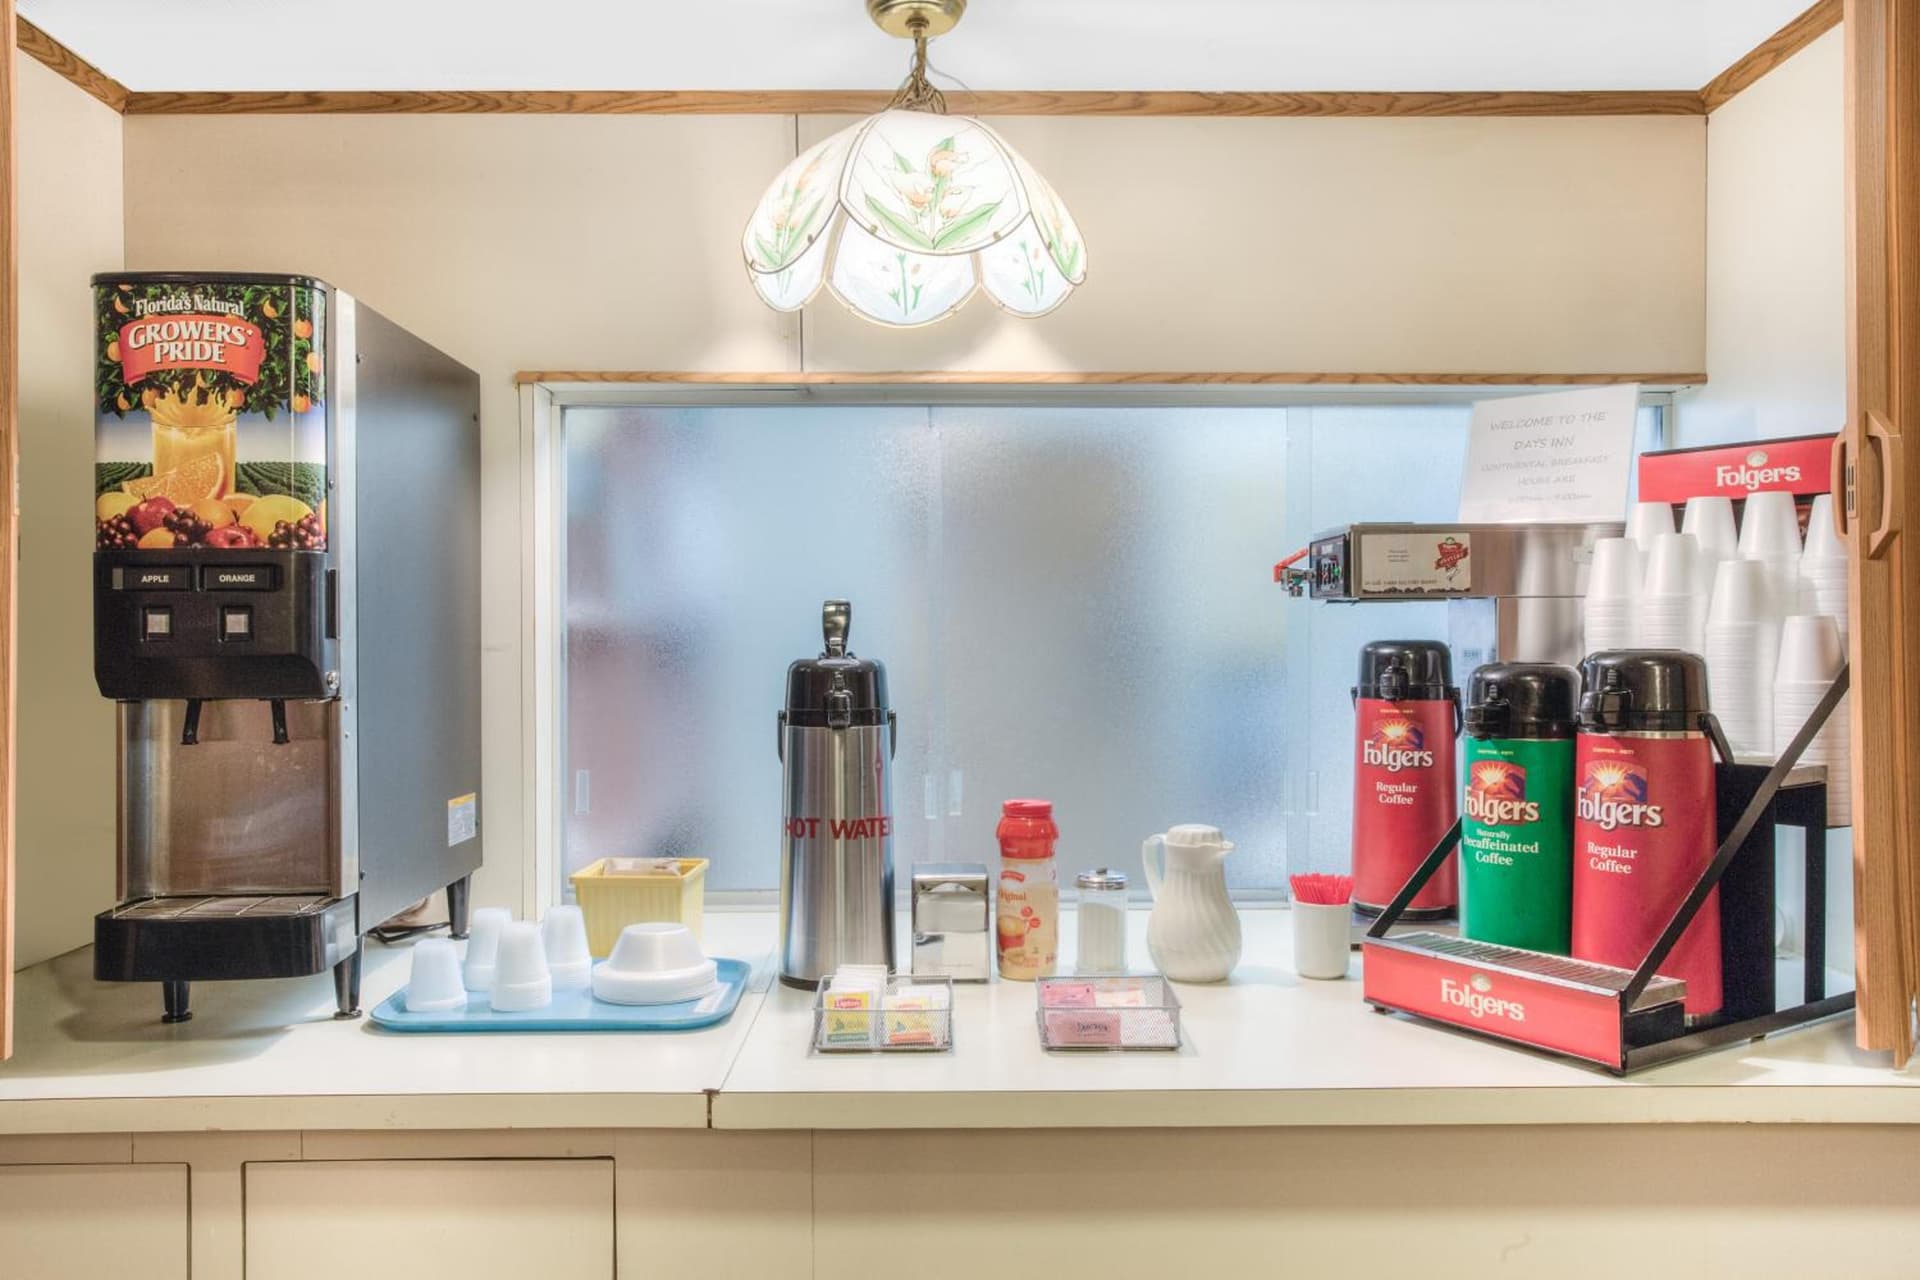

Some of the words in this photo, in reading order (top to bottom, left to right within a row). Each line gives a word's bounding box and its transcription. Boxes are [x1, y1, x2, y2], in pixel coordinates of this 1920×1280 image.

[193, 293, 245, 316] Natural
[153, 341, 226, 364] PRIDE
[1490, 415, 1553, 431] WELCOME
[1559, 414, 1576, 425] TO
[1581, 411, 1608, 423] THE
[1513, 438, 1547, 450] DAYS
[1551, 436, 1575, 449] INN
[1716, 464, 1800, 490] Folgers
[141, 573, 169, 584] APPLE
[218, 573, 256, 584] ORANGE
[1363, 740, 1433, 772] Folgers
[1376, 781, 1417, 794] Regular
[1379, 794, 1414, 805] Coffee
[1464, 786, 1540, 826] Folgers
[1577, 787, 1663, 830] Folgers
[1476, 828, 1511, 841] Naturally
[1475, 850, 1514, 866] Coffee
[1587, 841, 1638, 860] Regular
[1589, 857, 1632, 874] Coffee
[1441, 978, 1526, 1019] Folgers
